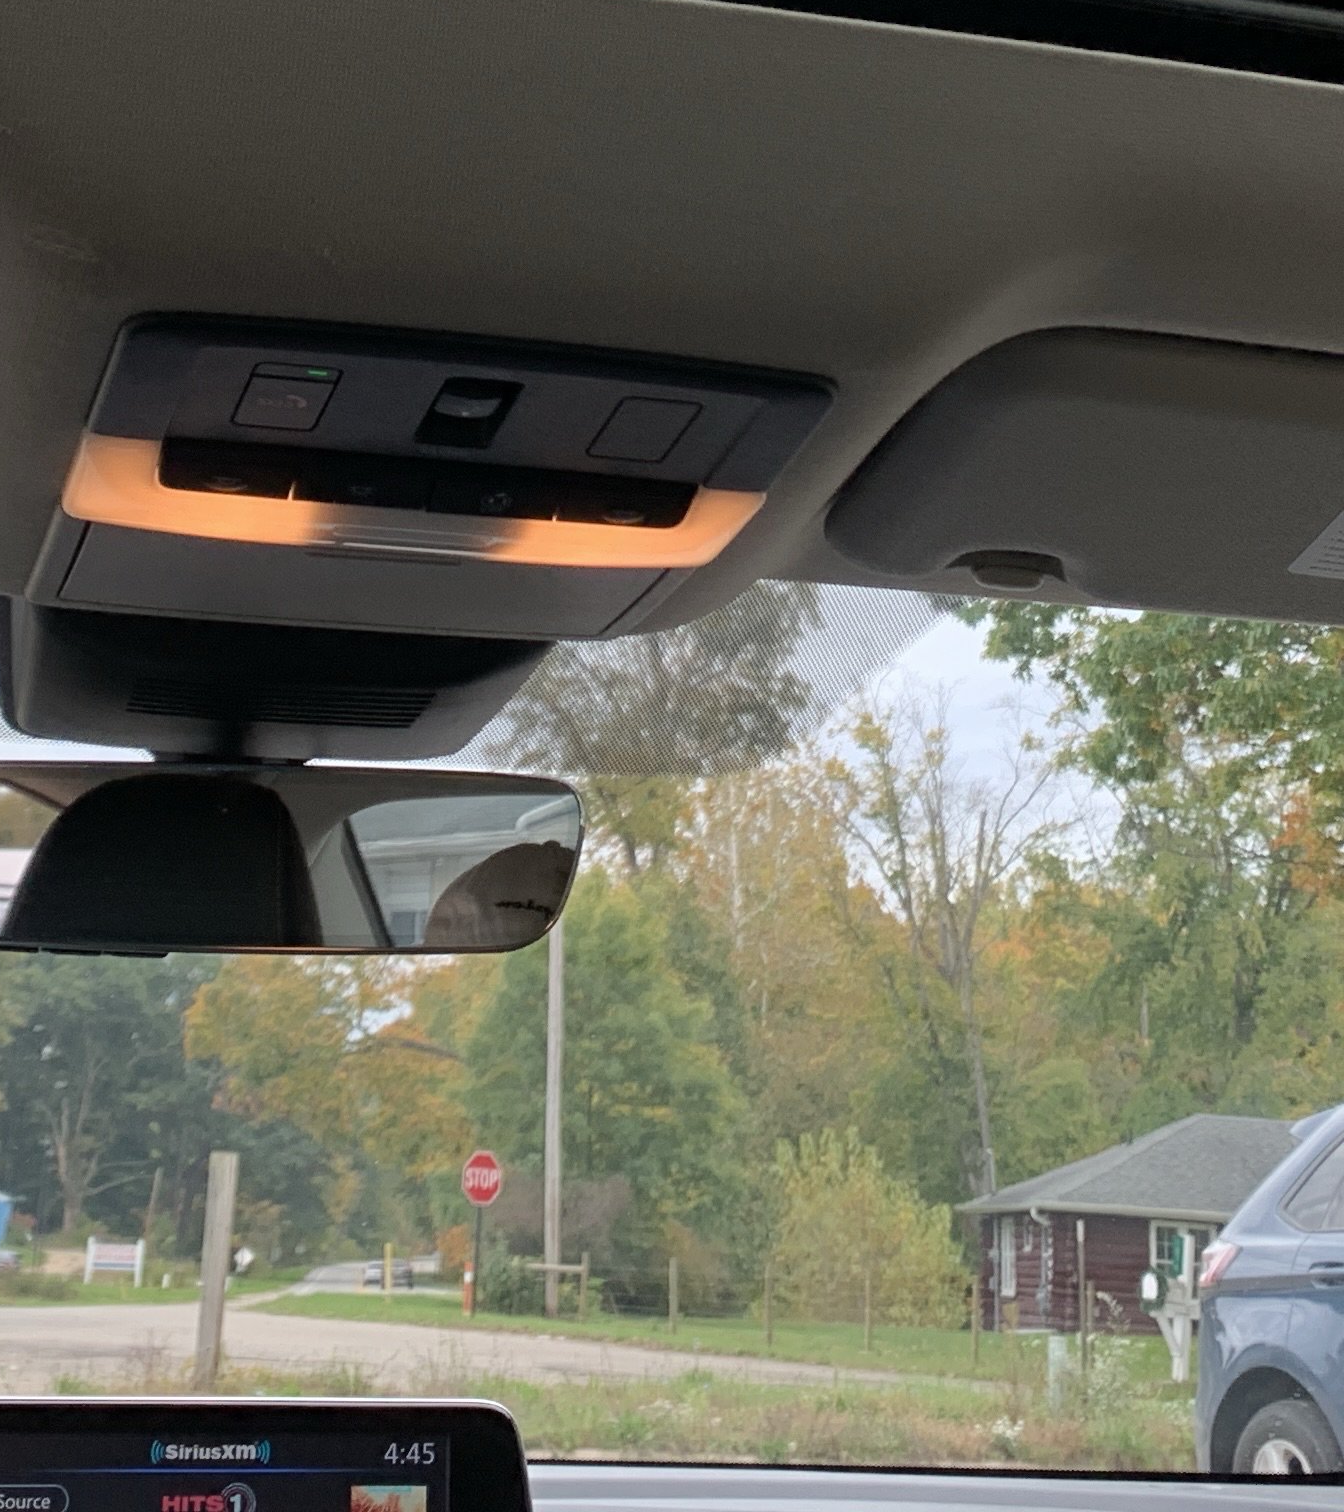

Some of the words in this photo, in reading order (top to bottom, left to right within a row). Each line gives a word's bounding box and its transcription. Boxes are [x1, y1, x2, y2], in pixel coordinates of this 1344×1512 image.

[465, 1167, 498, 1190] STOP
[383, 1442, 436, 1465] 4:45
[161, 1494, 225, 1512] HITS
[229, 1494, 242, 1512] 1
